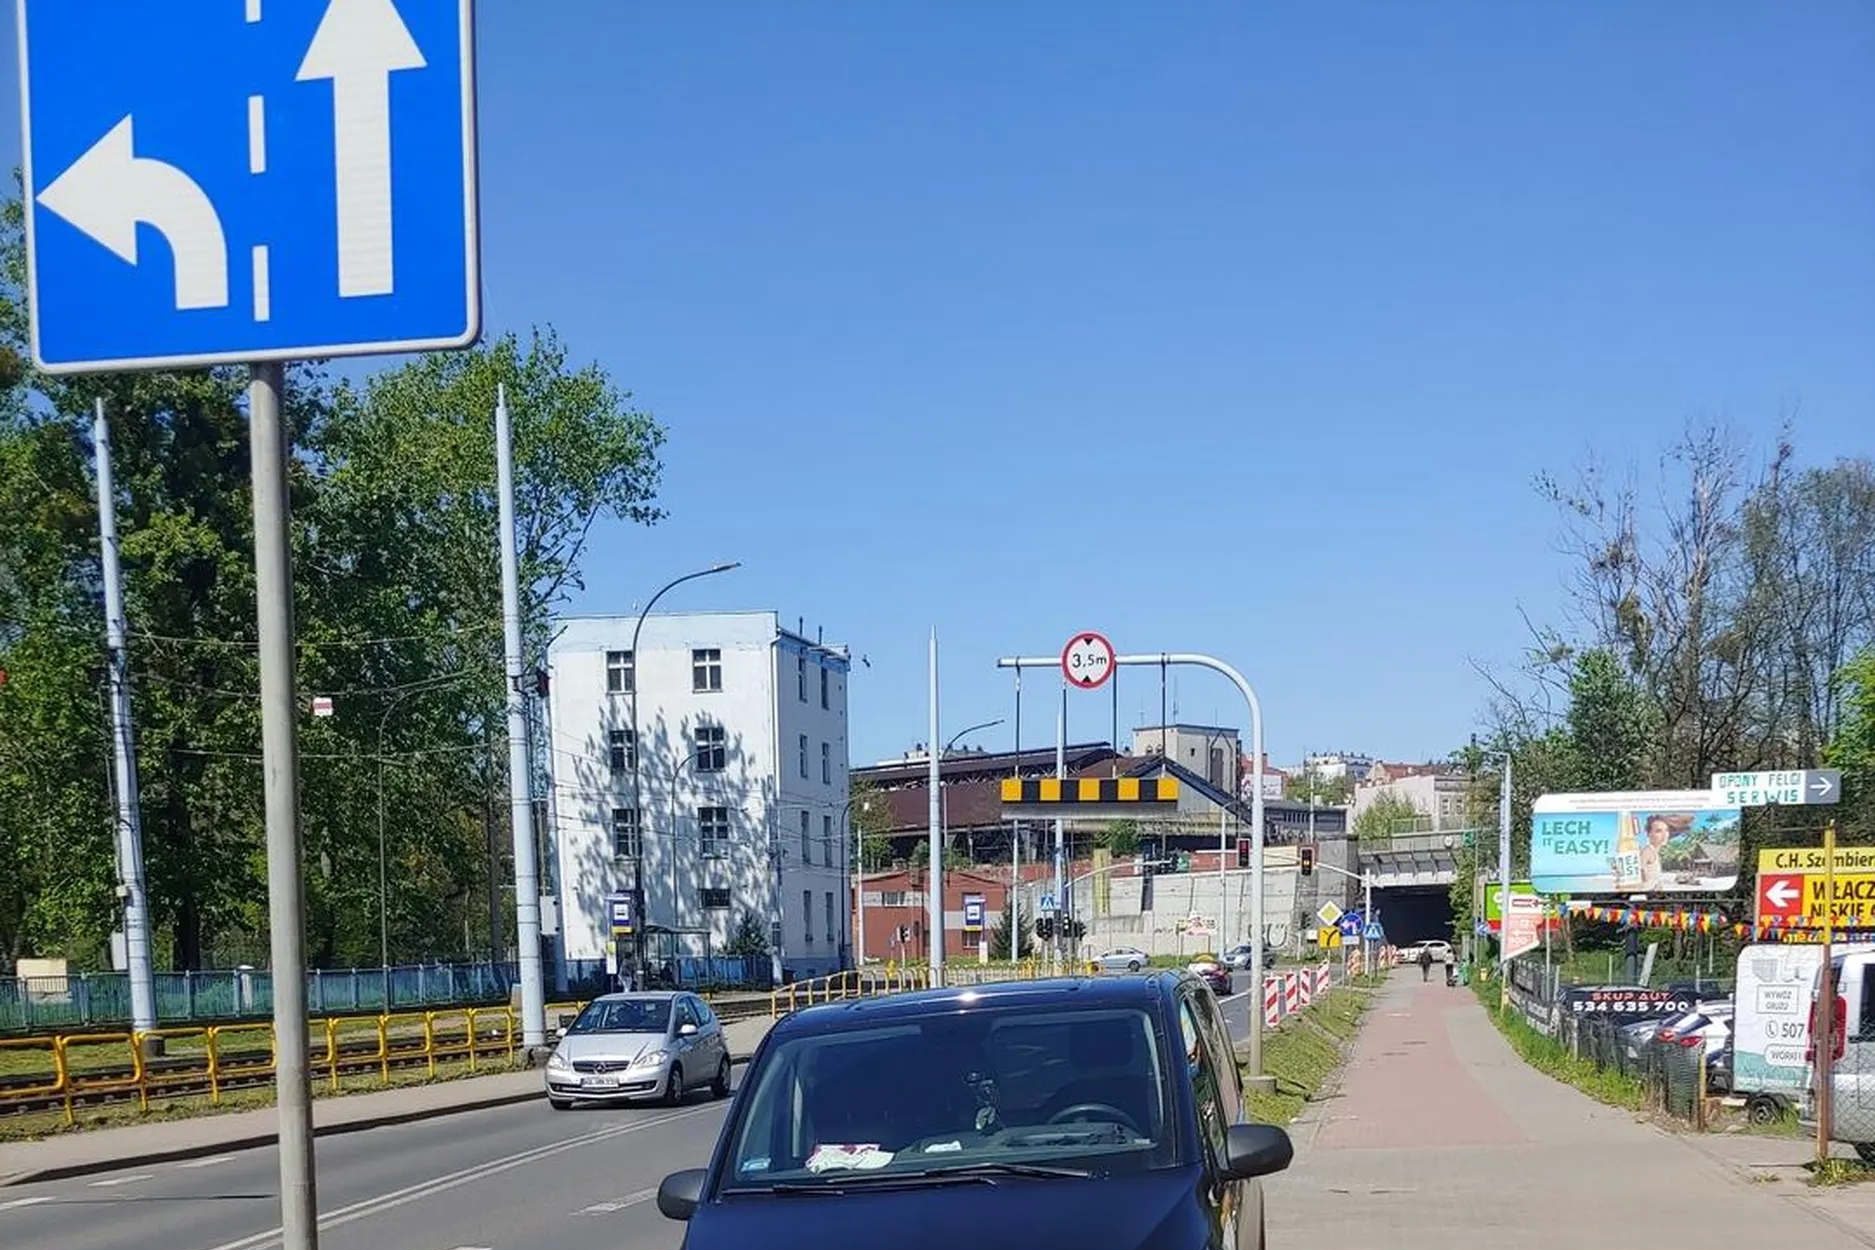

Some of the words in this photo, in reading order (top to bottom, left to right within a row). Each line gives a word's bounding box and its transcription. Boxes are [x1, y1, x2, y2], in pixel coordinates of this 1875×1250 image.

[1719, 774, 1758, 788] OPONY
[1727, 789, 1799, 804] SERWIS
[1541, 820, 1591, 836] LECH
[1555, 839, 1610, 855] EASY!
[1775, 853, 1803, 868] C.H.
[1592, 992, 1634, 1001] SKUP
[1640, 992, 1671, 1001] AUT
[1573, 1001, 1608, 1012] 534
[1613, 1001, 1650, 1012] 635
[1654, 1001, 1689, 1012] 700
[1781, 1023, 1805, 1038] 507
